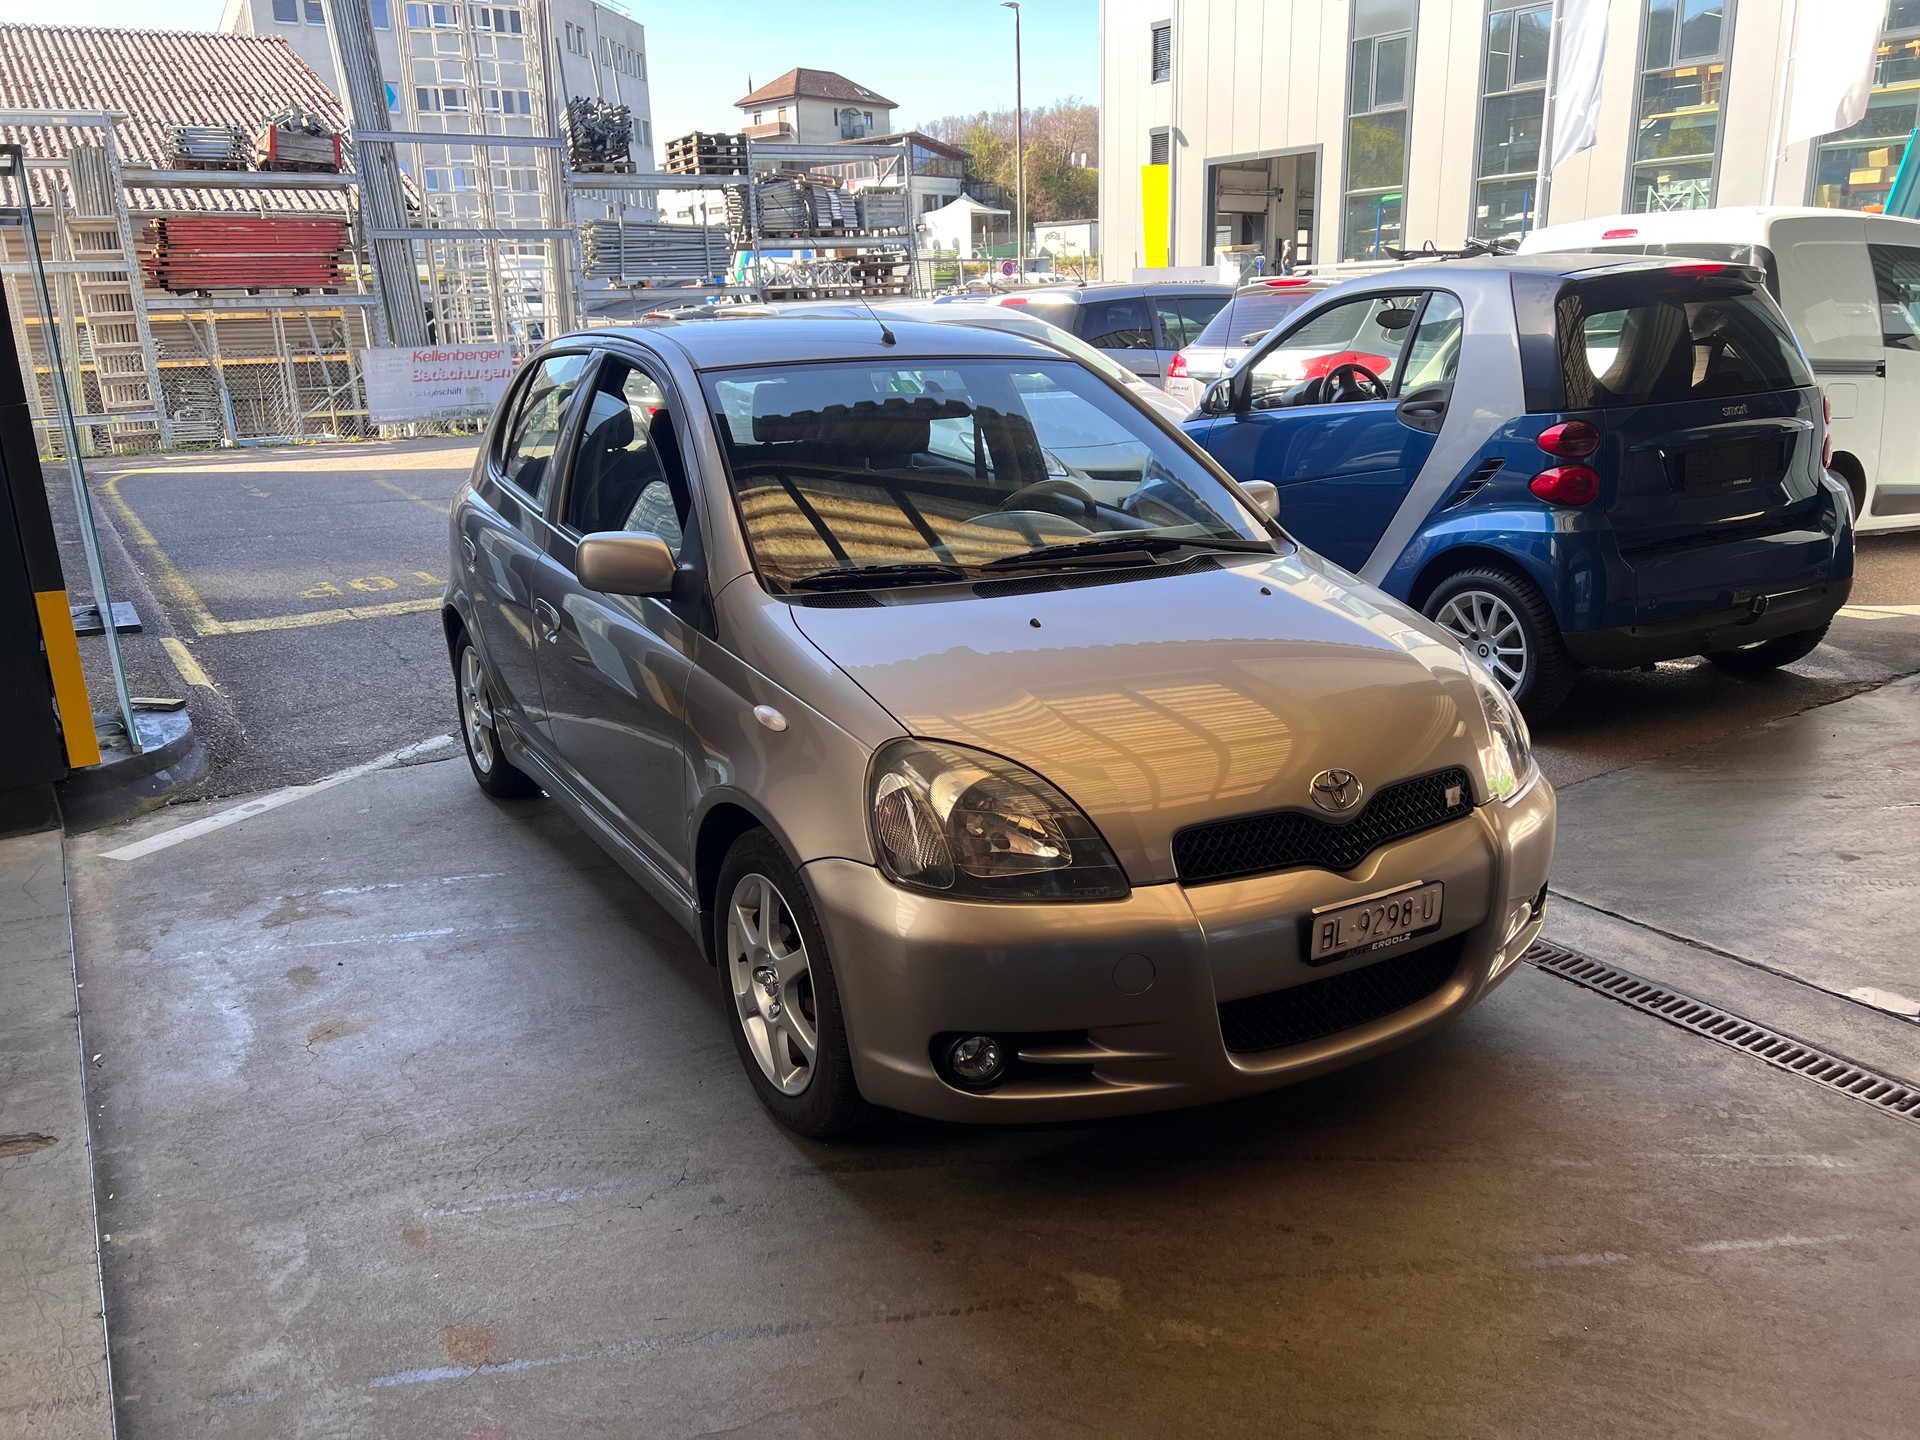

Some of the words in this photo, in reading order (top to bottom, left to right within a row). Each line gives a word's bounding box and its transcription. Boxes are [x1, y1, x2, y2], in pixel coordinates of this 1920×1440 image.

[412, 349, 504, 363] Kellenberger
[411, 366, 511, 382] Bedachungen
[1722, 403, 1748, 416] smart
[1320, 917, 1349, 954] BL
[1358, 896, 1414, 943] 9298
[1421, 889, 1437, 923] U
[1371, 932, 1412, 951] ERGOLZ
